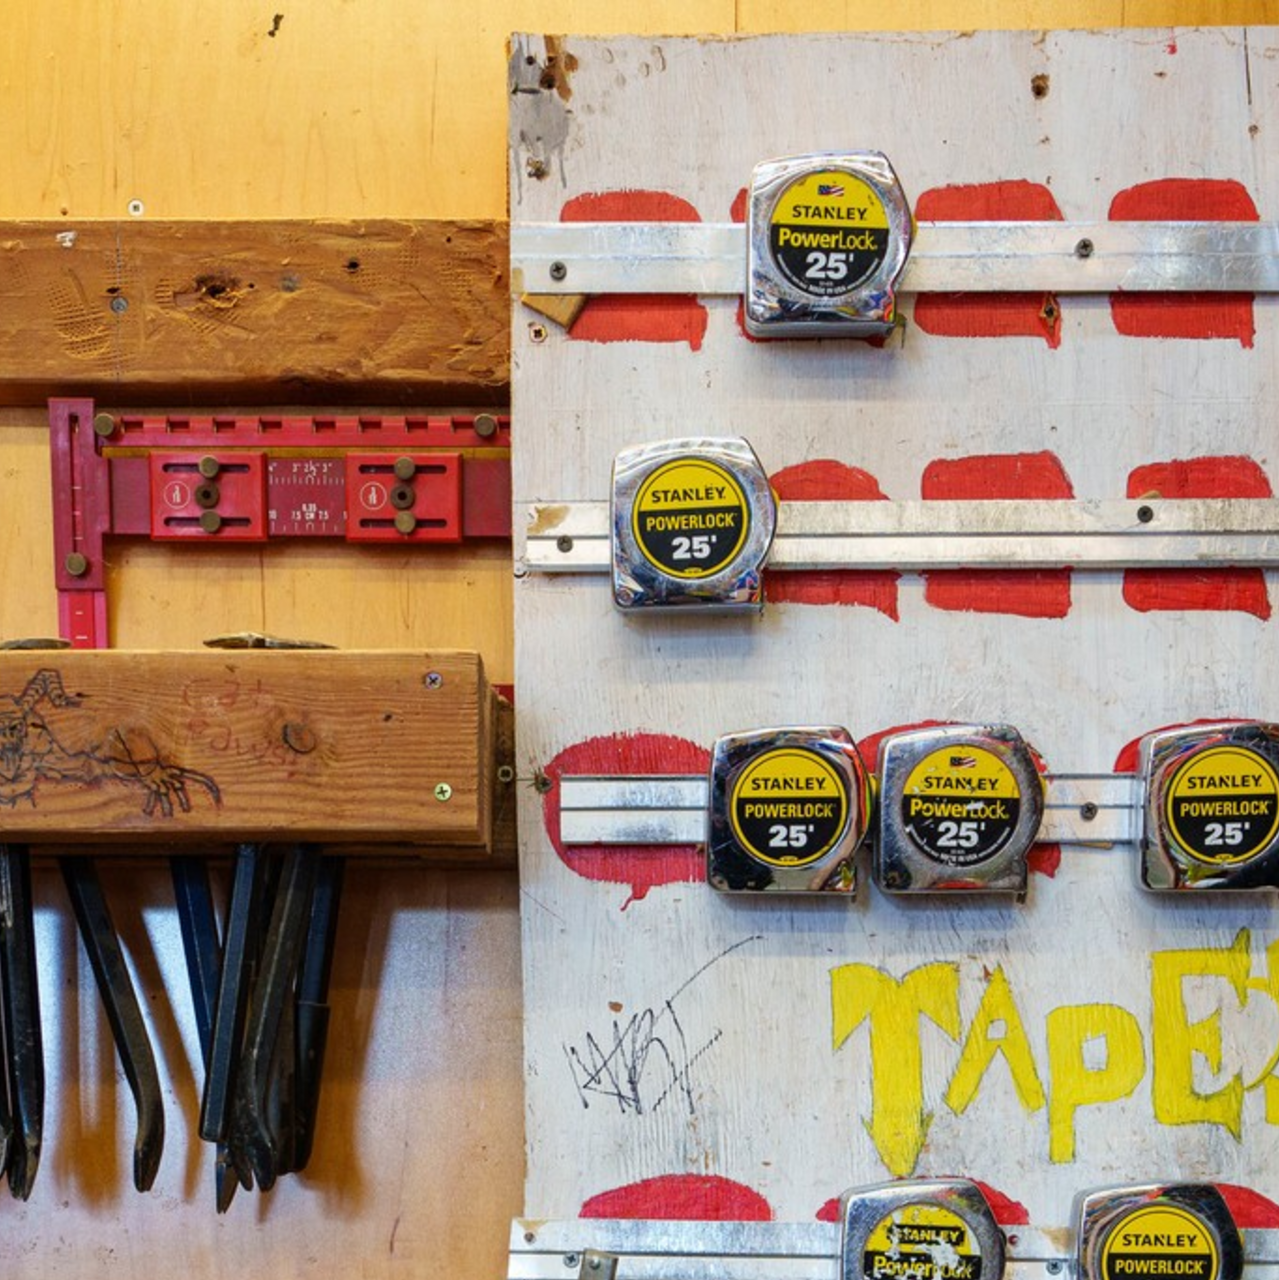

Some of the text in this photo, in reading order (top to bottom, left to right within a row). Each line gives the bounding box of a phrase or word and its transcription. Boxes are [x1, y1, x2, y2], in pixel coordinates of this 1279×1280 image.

[792, 205, 868, 221] STANLEY
[778, 228, 875, 250] PowerLock
[805, 252, 854, 280] 25'
[651, 486, 727, 503] STANLEY
[646, 513, 736, 532] POWERLOCK
[671, 535, 717, 560] 25'
[751, 777, 827, 791] STANLEY
[923, 776, 999, 791] STANLEY
[1187, 775, 1263, 789] STANLEY
[745, 803, 833, 819] POWERLOCK
[910, 798, 1007, 820] PowerLock
[1180, 801, 1269, 817] POWERLOCK
[768, 824, 814, 848] 25'
[936, 821, 985, 848] 25'
[1204, 821, 1250, 846] 25'
[1122, 1234, 1198, 1247] STANLEY
[1115, 1259, 1204, 1275] POWERLOCK
